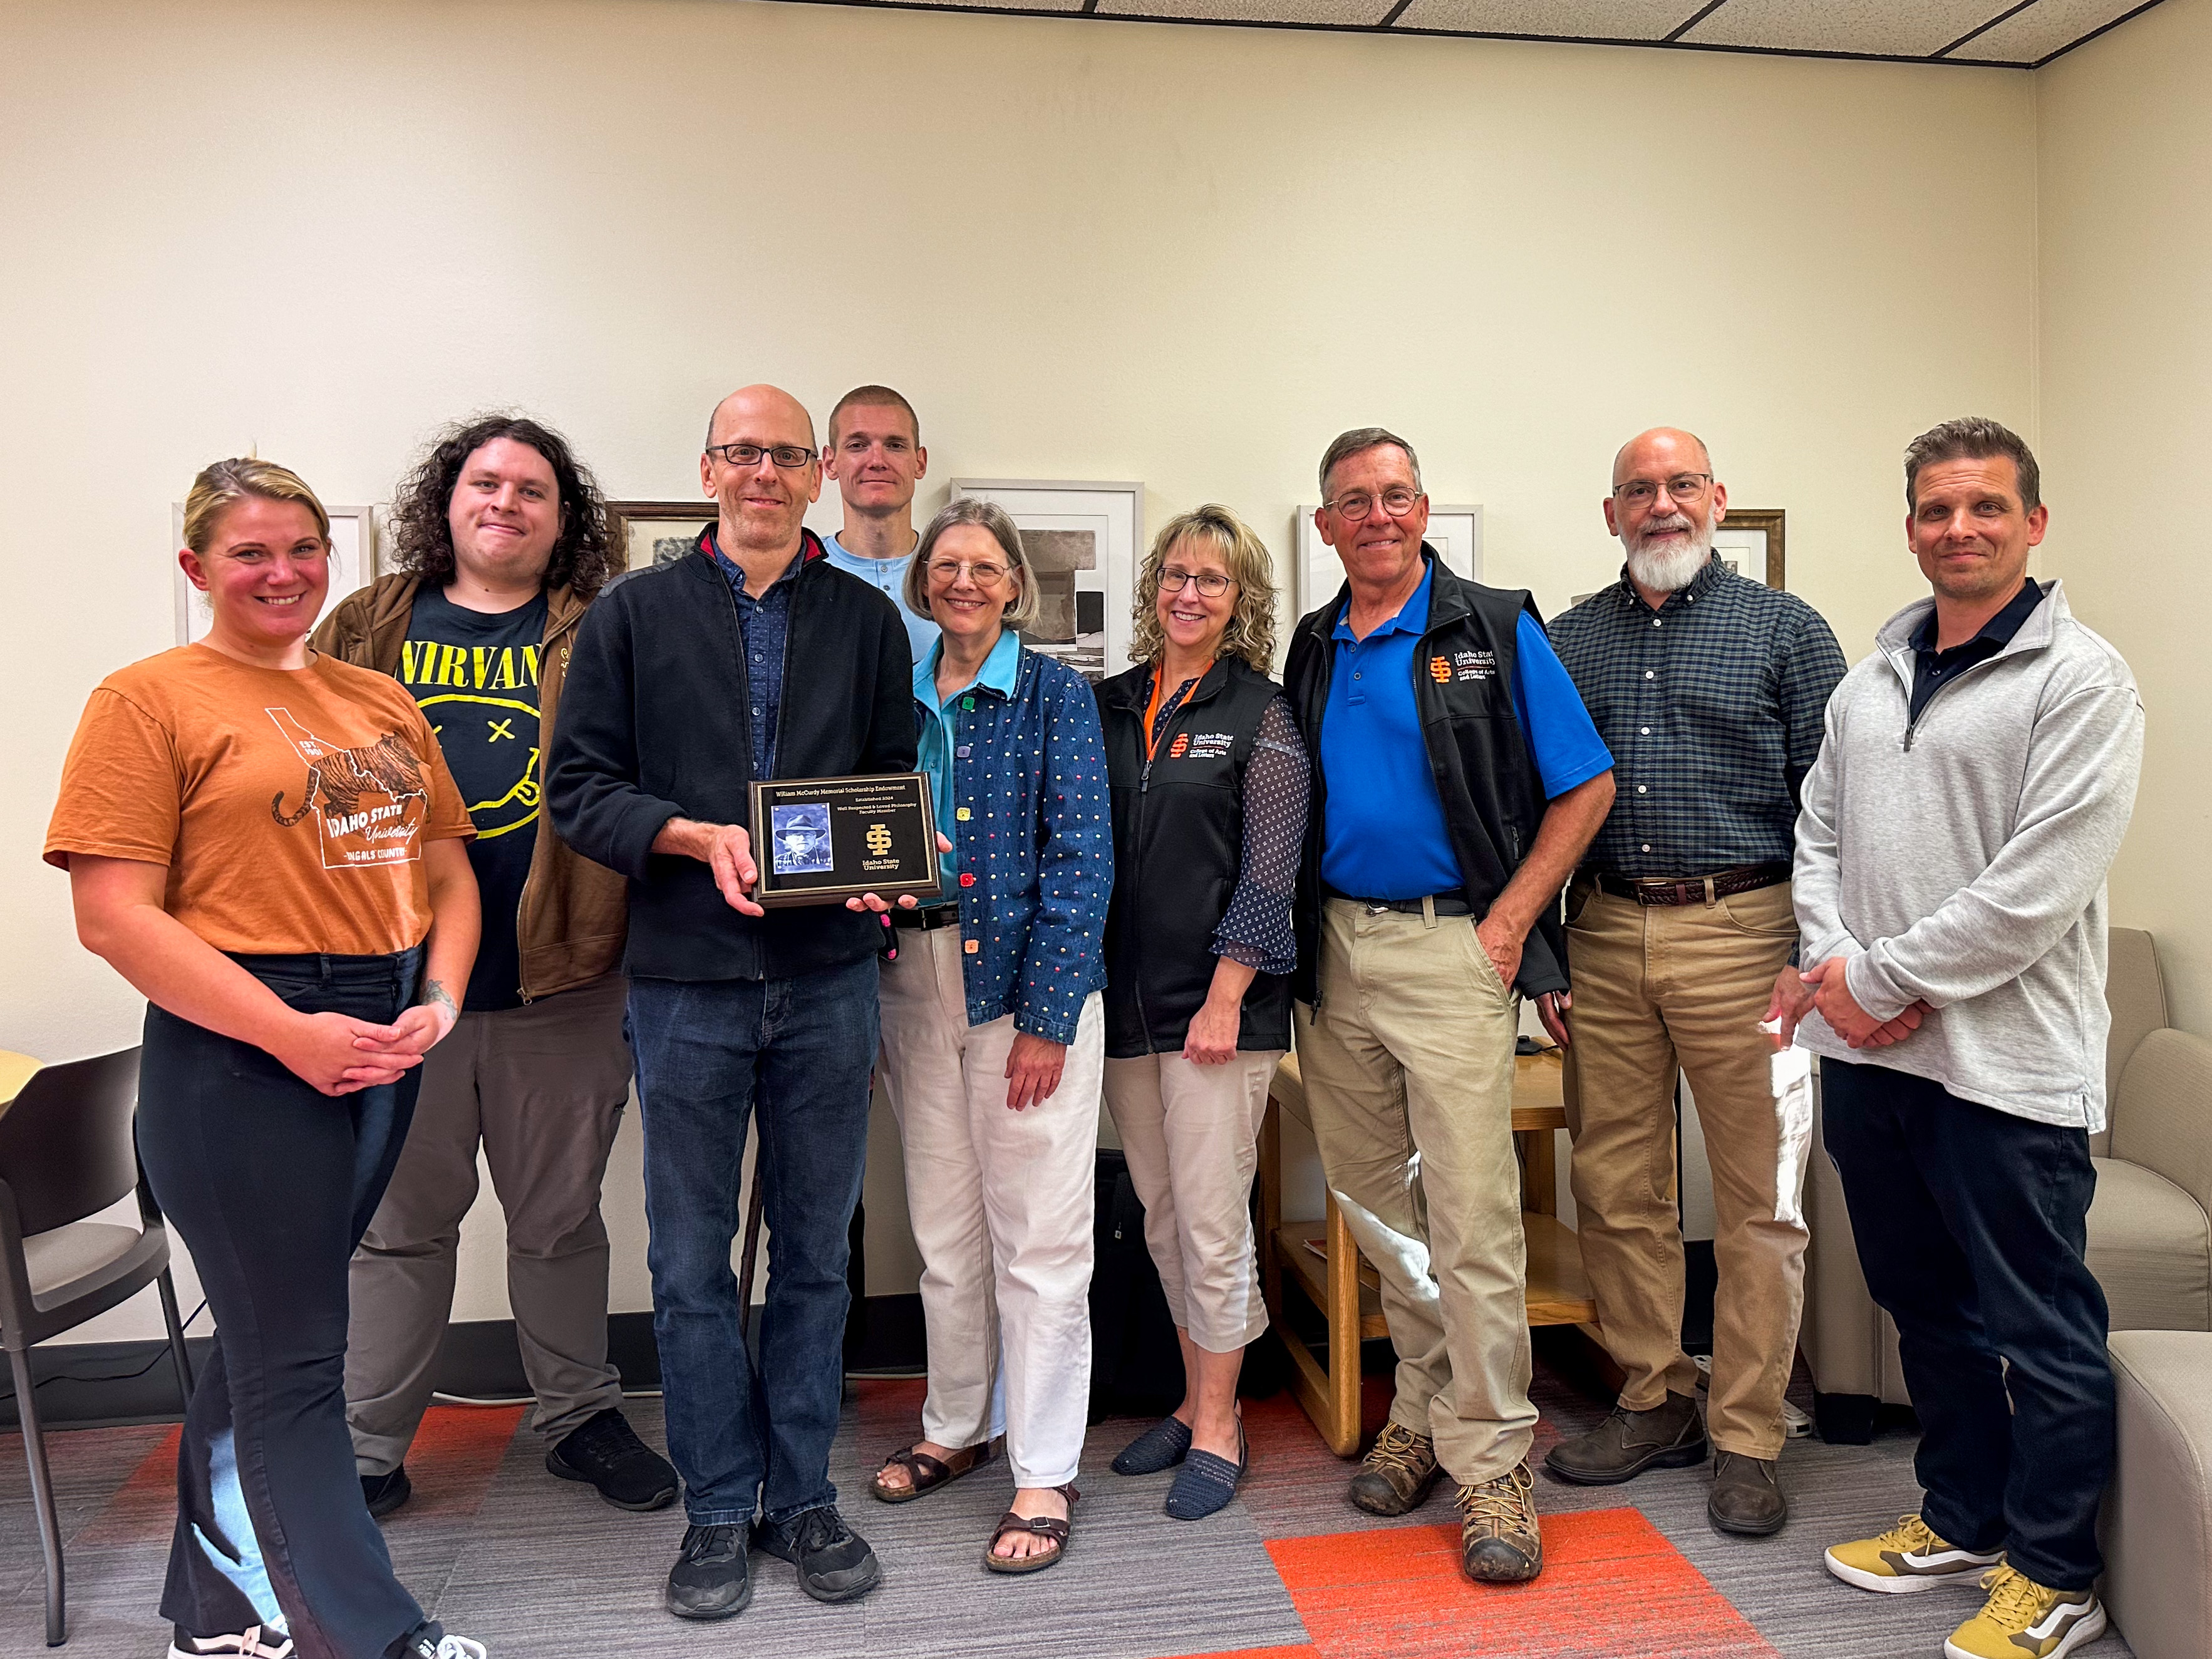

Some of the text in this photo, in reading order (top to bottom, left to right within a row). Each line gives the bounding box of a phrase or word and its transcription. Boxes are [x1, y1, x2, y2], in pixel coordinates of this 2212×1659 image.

[1454, 651, 1477, 660] Idaho
[395, 640, 542, 690] NIRVAN
[1455, 658, 1495, 666] University
[1215, 733, 1234, 741] State
[299, 740, 319, 748] EST.
[1193, 739, 1231, 748] University
[304, 748, 324, 756] 1901
[326, 804, 402, 839] IDAHO STATE
[365, 817, 420, 845] University
